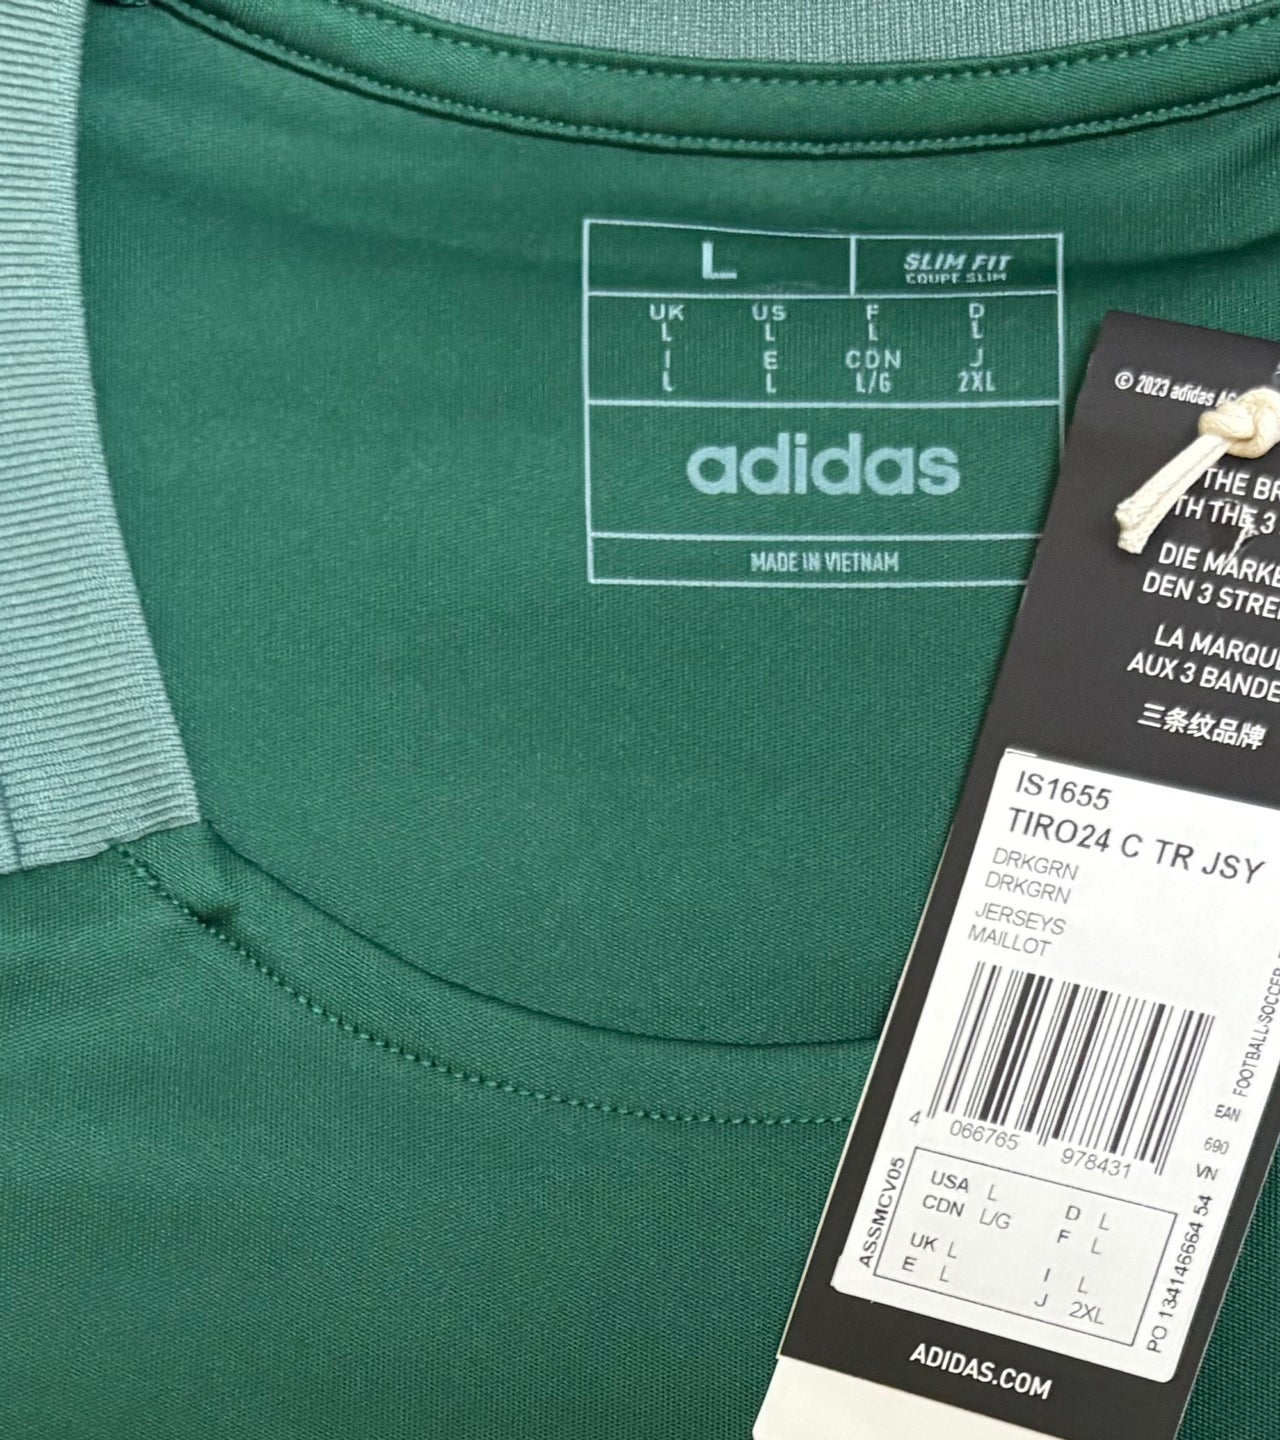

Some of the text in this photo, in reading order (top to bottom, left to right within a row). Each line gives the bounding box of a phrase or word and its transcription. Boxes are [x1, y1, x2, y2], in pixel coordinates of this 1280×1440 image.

[702, 241, 737, 279] L
[904, 253, 1011, 271] SLIM FIT
[966, 271, 1007, 283] SLIM
[649, 304, 684, 321] UK
[752, 304, 786, 321] US
[866, 304, 879, 320] F
[969, 302, 984, 319] D
[661, 323, 673, 341] L
[765, 323, 775, 341] L
[868, 322, 879, 341] L
[971, 320, 983, 339] L
[664, 350, 671, 368] I
[763, 350, 778, 369] E
[845, 350, 902, 369] CDN
[970, 348, 984, 367] J
[662, 371, 674, 392] L
[766, 373, 776, 393] L
[855, 371, 892, 393] L/G
[958, 371, 996, 392] 2XL
[1135, 375, 1170, 397] 2023
[1170, 384, 1215, 407] adidas
[687, 433, 960, 496] adidas
[1204, 467, 1249, 496] THE
[1208, 498, 1259, 529] THE
[1260, 512, 1276, 534] 3
[750, 552, 900, 573] MADE IN VIETNAM
[1158, 542, 1200, 570] DIE
[1142, 571, 1194, 600] DEN
[1197, 583, 1214, 605] 3
[1154, 624, 1183, 649] LA
[1127, 652, 1178, 681] AUX
[1180, 662, 1196, 684] 3
[1137, 703, 1267, 750] 三条纹品牌
[1015, 770, 1112, 811] IS1655
[1009, 807, 1267, 884] TIRO24 C TR JSY
[992, 847, 1080, 881] DRKGRN
[985, 871, 1072, 904] DRKGRN
[975, 902, 1067, 935] JERSEYS
[967, 924, 1053, 956] MAILLOT
[1213, 1103, 1242, 1122] EAN
[909, 1110, 1132, 1179] 4 066765 978431
[1203, 1136, 1230, 1156] 690
[929, 1169, 998, 1202] USA L
[1195, 1163, 1219, 1181] VN
[858, 1157, 906, 1269] ASSMCV05
[922, 1194, 1012, 1230] CDN L/G
[1065, 1204, 1111, 1231] D L
[909, 1231, 958, 1259] UK L
[1056, 1229, 1102, 1256] F L
[901, 1255, 950, 1283] E L
[1043, 1267, 1088, 1294] I L
[1146, 1193, 1213, 1354] PO 134146664 54
[1034, 1292, 1105, 1326] J 2XL
[909, 1342, 1053, 1401] ADIDAS.COM
